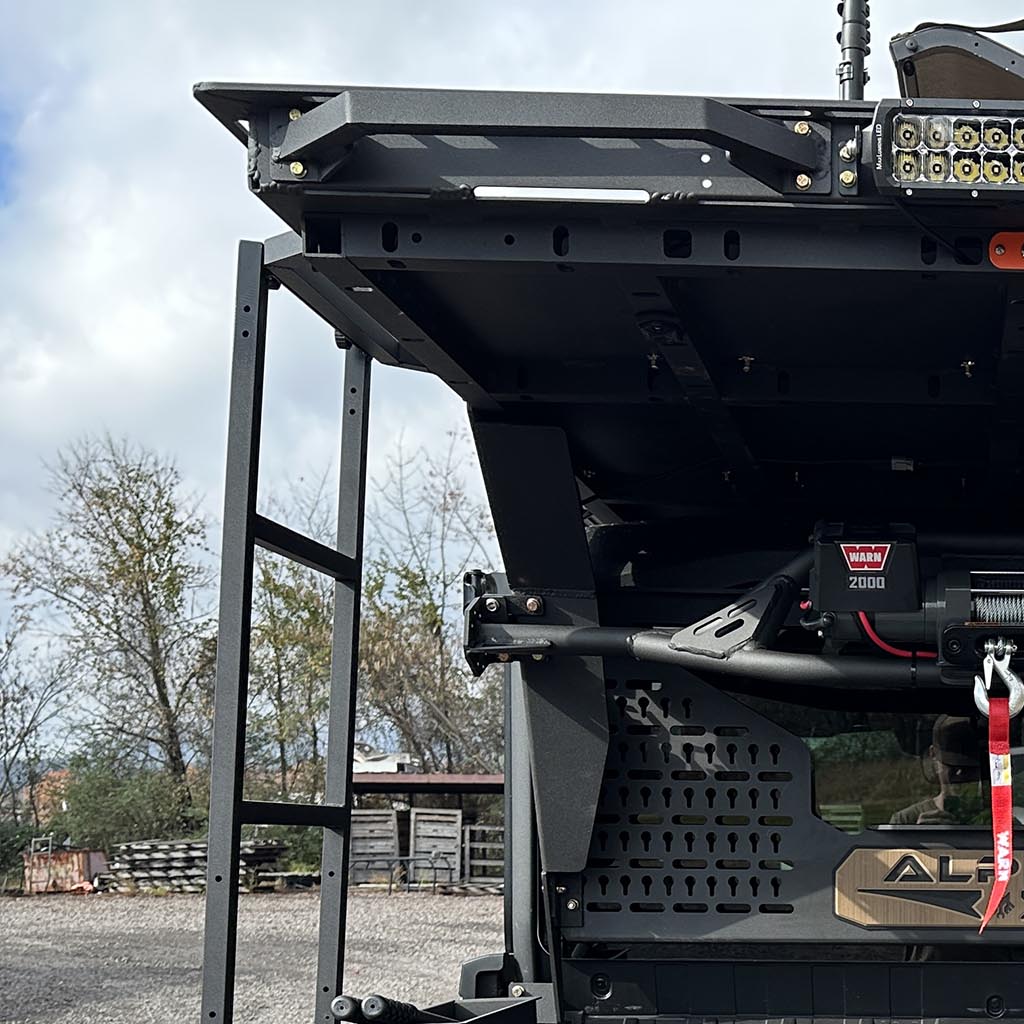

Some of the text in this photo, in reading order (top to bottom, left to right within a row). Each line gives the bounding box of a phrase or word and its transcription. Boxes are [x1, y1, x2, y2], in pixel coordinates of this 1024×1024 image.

[849, 552, 882, 562] WARN
[849, 576, 885, 589] 2000
[996, 830, 1010, 882] WARN
